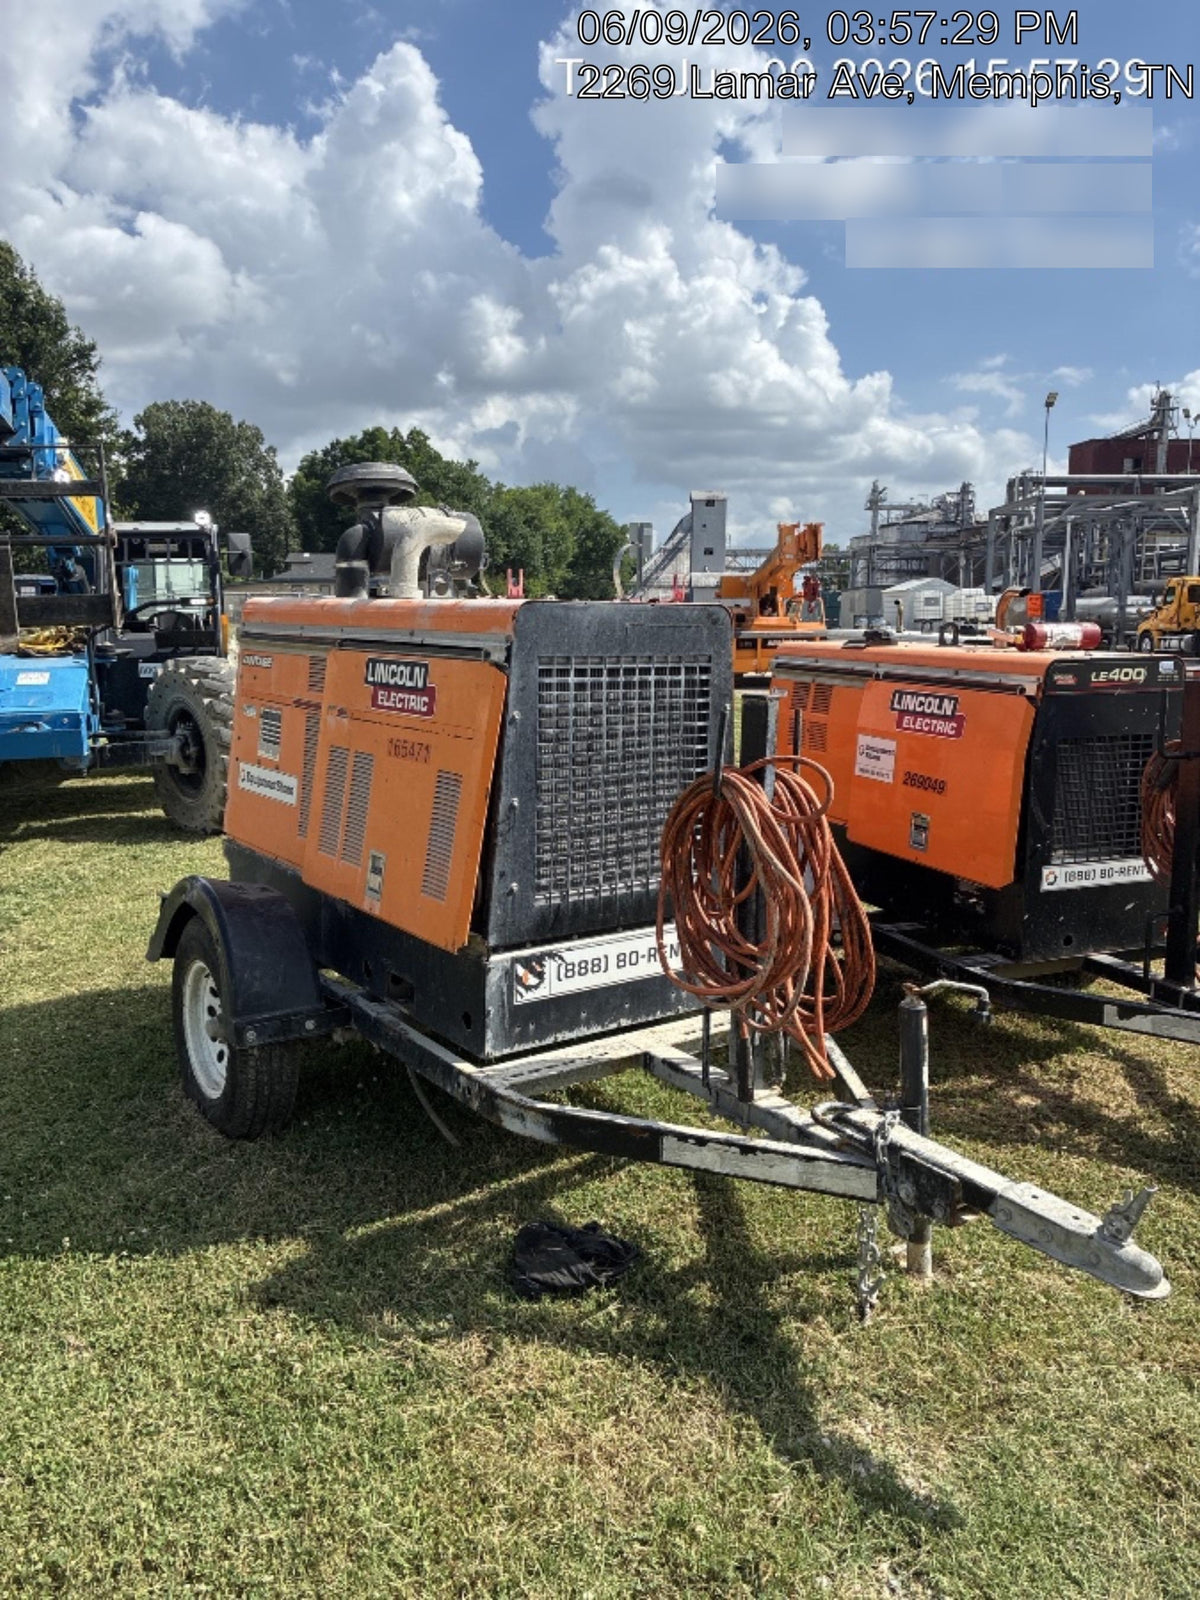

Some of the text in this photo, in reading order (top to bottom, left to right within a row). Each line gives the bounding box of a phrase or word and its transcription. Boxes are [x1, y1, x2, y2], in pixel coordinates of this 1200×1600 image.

[367, 661, 426, 689] LINCOLN
[1091, 667, 1146, 684] LE400
[377, 690, 429, 712] ELECTRIC
[892, 692, 956, 716] LINCOLN
[902, 716, 958, 735] ELECTRIC
[902, 770, 947, 796] 269049
[555, 954, 610, 982] (888)
